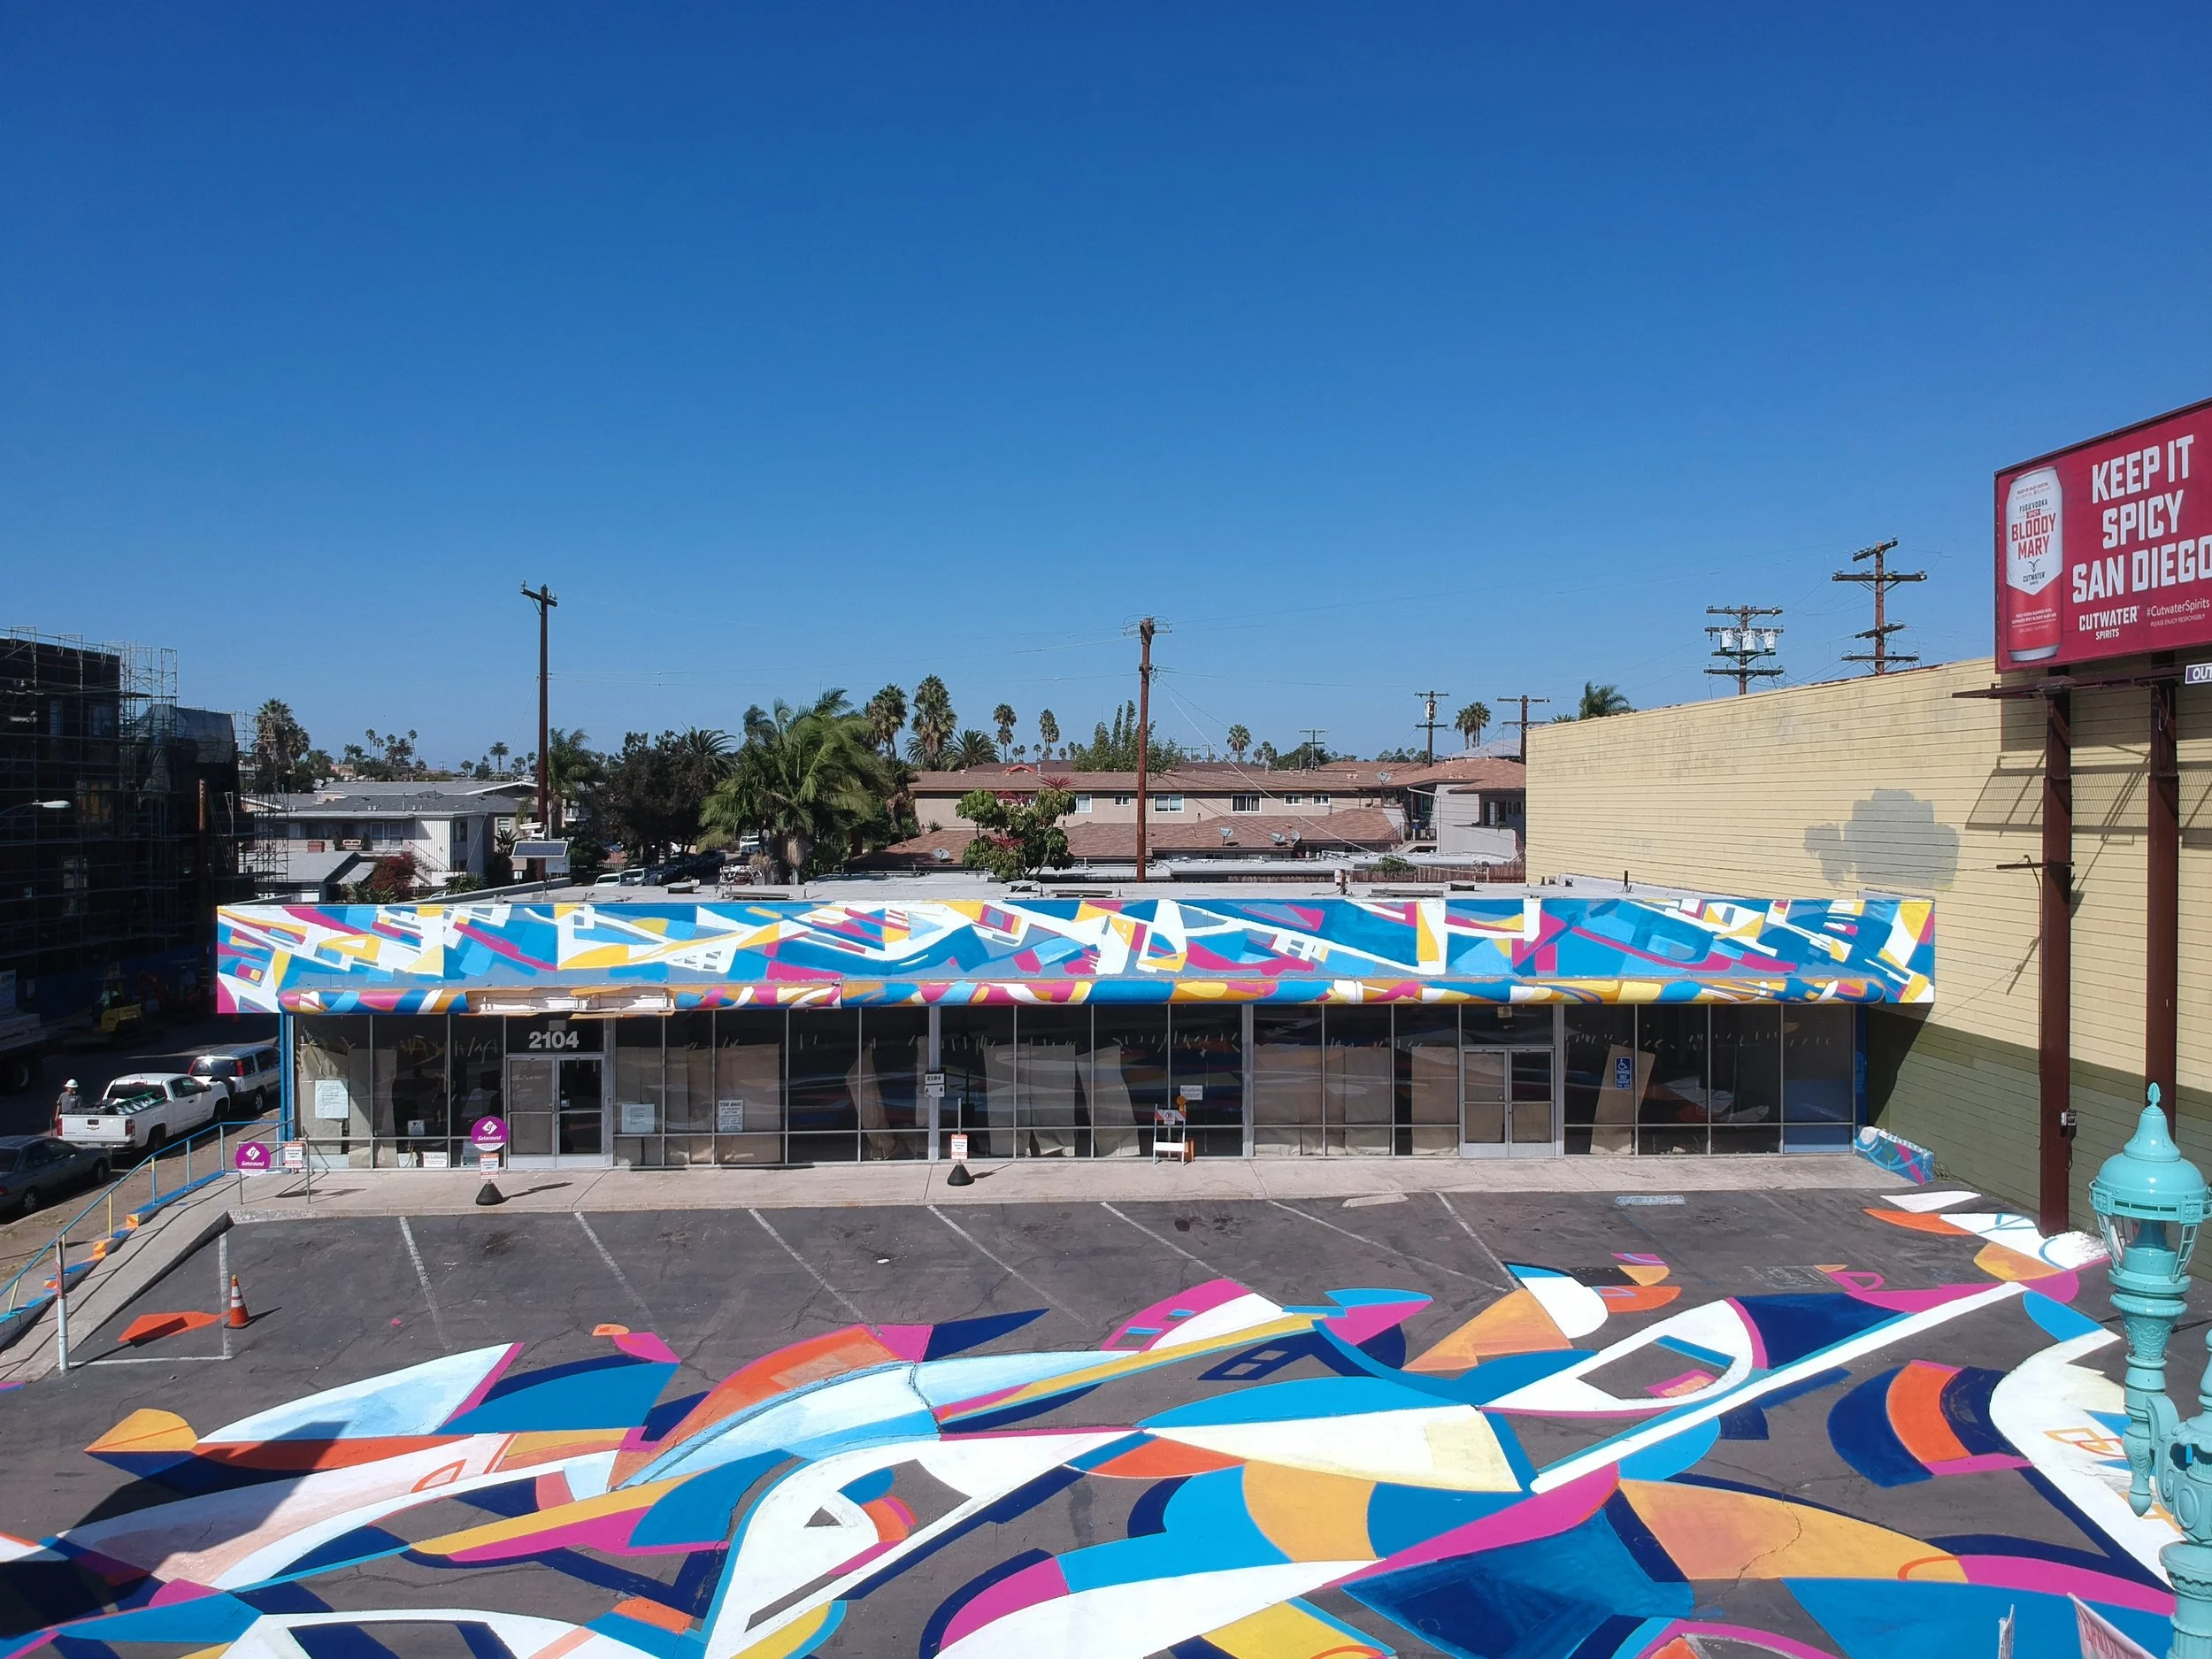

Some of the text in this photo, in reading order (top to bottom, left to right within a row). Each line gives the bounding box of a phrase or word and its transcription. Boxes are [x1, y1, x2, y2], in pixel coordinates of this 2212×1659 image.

[2092, 434, 2194, 504] KEEP IT
[2011, 513, 2056, 541] BLOODY
[2102, 489, 2184, 549] SPICY
[2018, 534, 2050, 560] MARY
[2072, 534, 2212, 603] SAN DIEGO
[2078, 605, 2138, 632] CUTWATER
[2147, 597, 2210, 618] #CutwaterSpirits
[2095, 628, 2120, 641] SPIRITS
[529, 1030, 580, 1048] 2104
